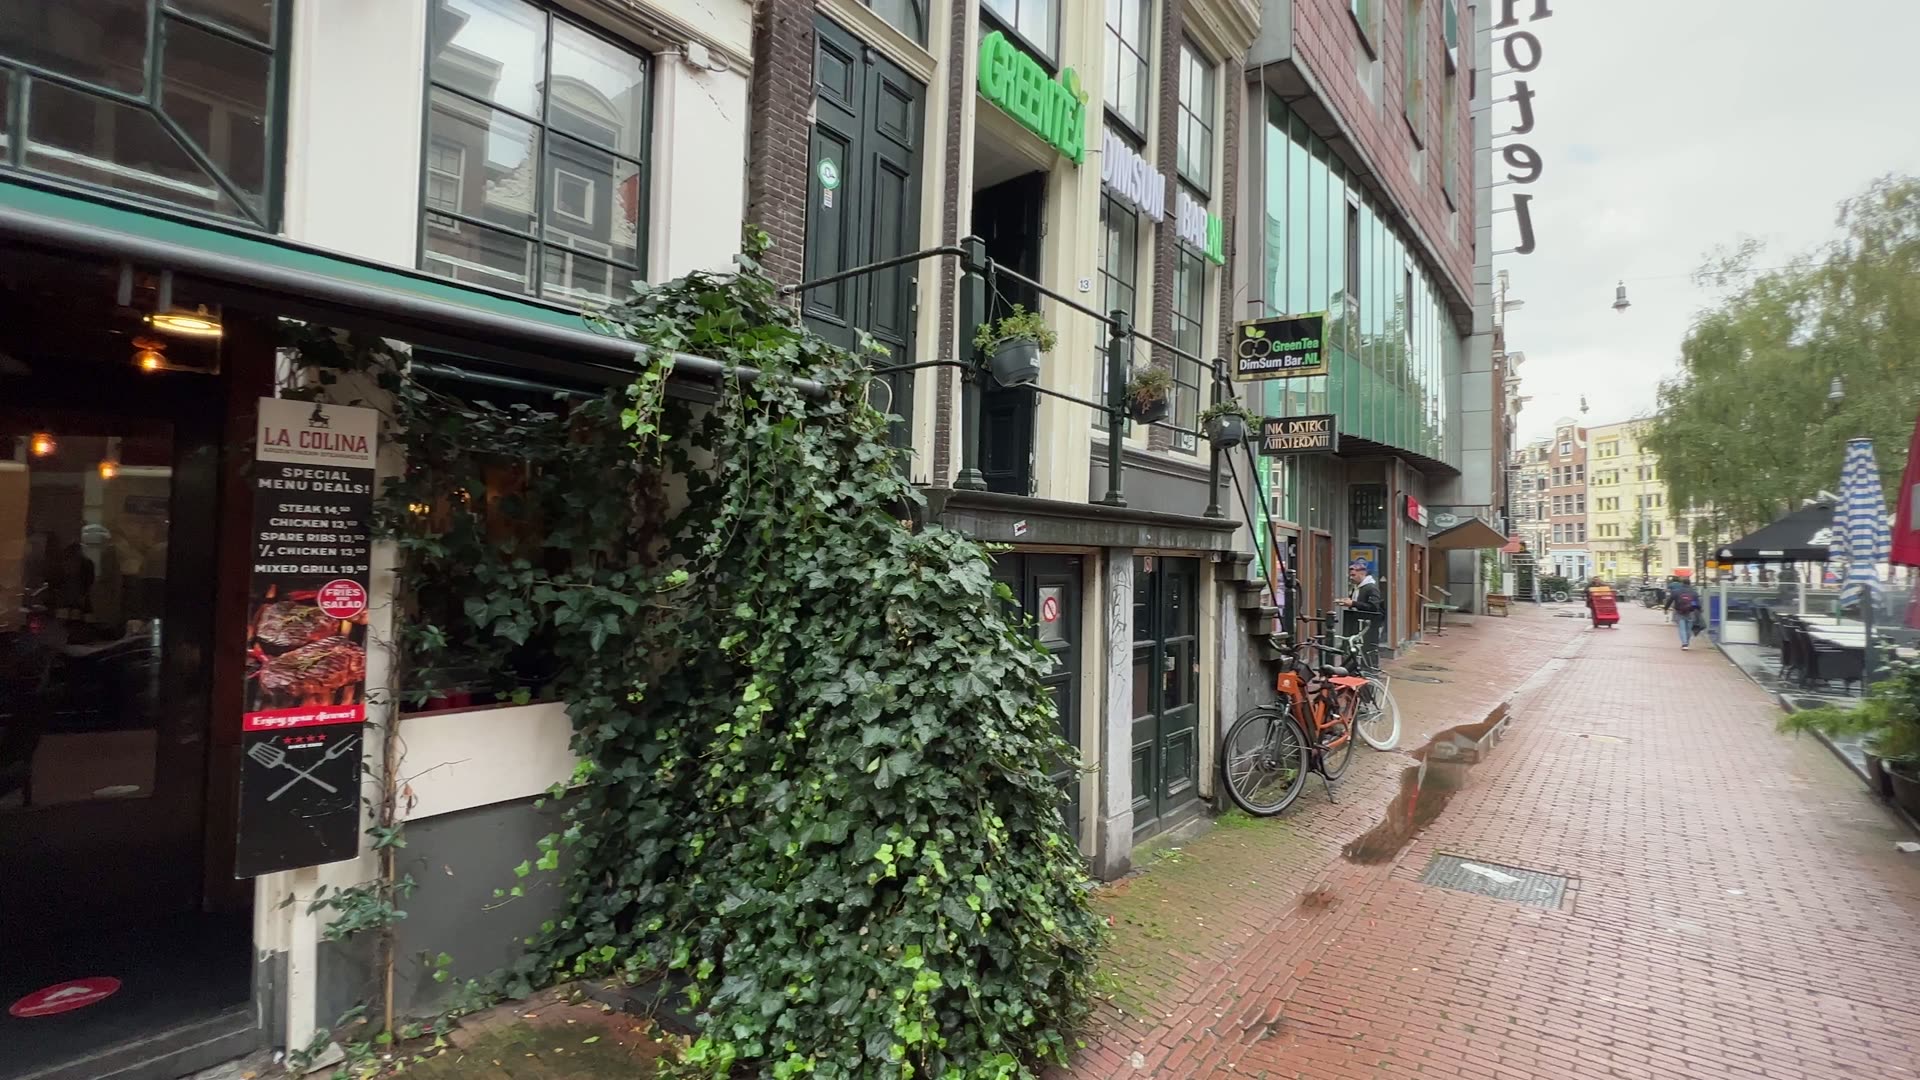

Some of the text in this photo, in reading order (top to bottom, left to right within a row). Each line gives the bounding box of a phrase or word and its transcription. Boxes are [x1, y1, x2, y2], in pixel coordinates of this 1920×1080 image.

[1101, 129, 1166, 223] DIMSUM
[1079, 279, 1090, 290] 13
[1239, 357, 1282, 371] DimSum
[1284, 352, 1321, 367] Bar.NL
[1264, 419, 1331, 435] INK DISTRICT
[264, 427, 369, 454] LA COLINA
[1263, 435, 1330, 449] AMSTERDAM
[281, 467, 351, 481] SPECIAL
[258, 478, 370, 494] MENU DEALS!
[278, 503, 321, 514] STEAK
[269, 517, 329, 528] CHICKEN
[260, 532, 304, 541] SPARE
[306, 534, 337, 542] RIBS
[277, 547, 337, 556] CHICKEN
[254, 564, 299, 573] MIXED
[300, 565, 338, 574] GRILL
[325, 588, 361, 597] FRIES
[322, 600, 362, 609] SALAD
[252, 716, 287, 727] Enjoy
